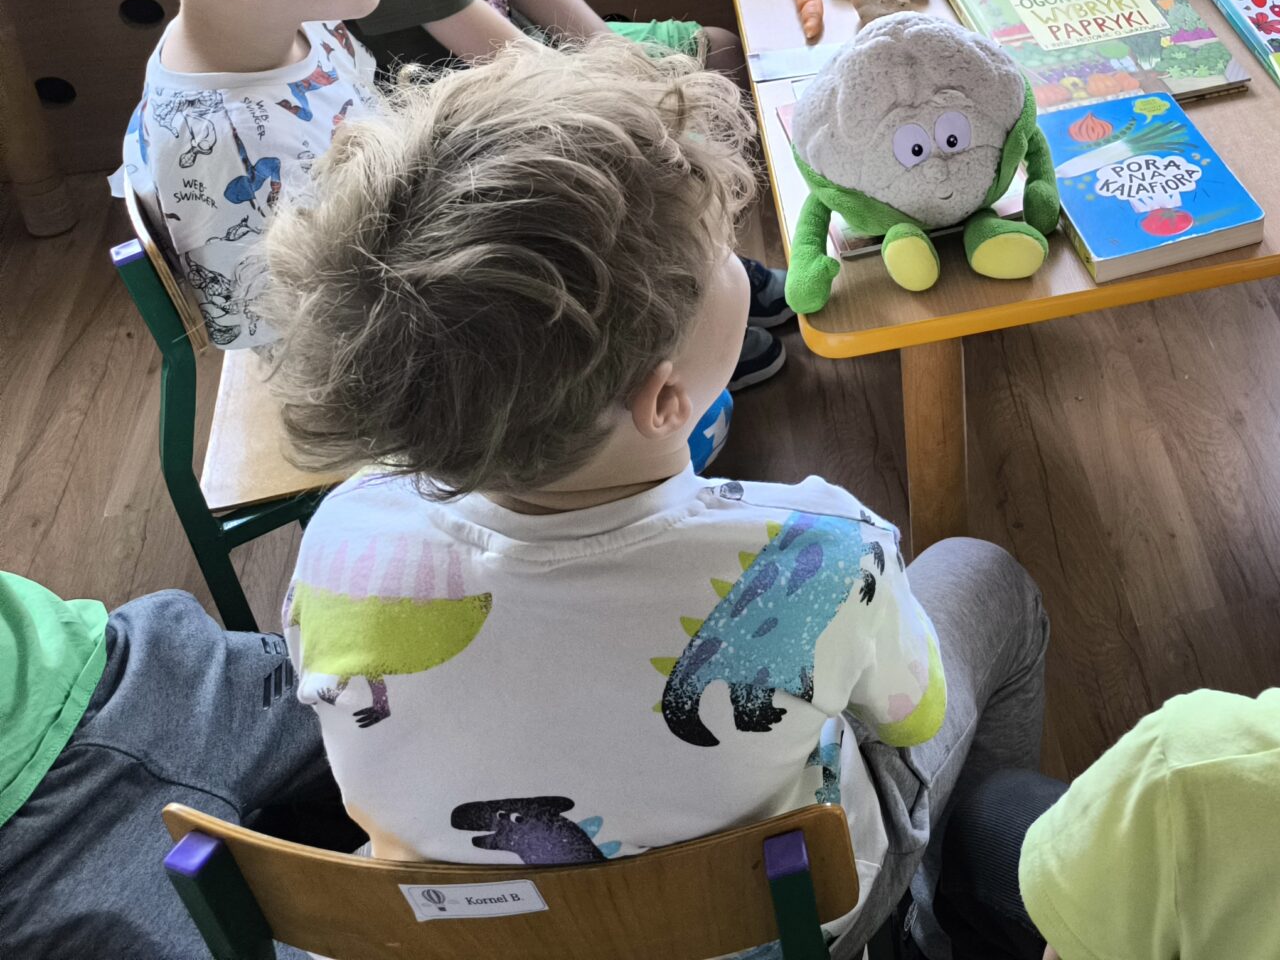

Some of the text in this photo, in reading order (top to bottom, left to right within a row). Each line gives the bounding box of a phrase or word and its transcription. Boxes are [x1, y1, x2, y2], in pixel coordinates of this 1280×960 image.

[1047, 9, 1150, 42] PAPRYKI
[1111, 158, 1182, 178] PORA
[1128, 170, 1166, 184] NA
[464, 894, 508, 906] Kornel
